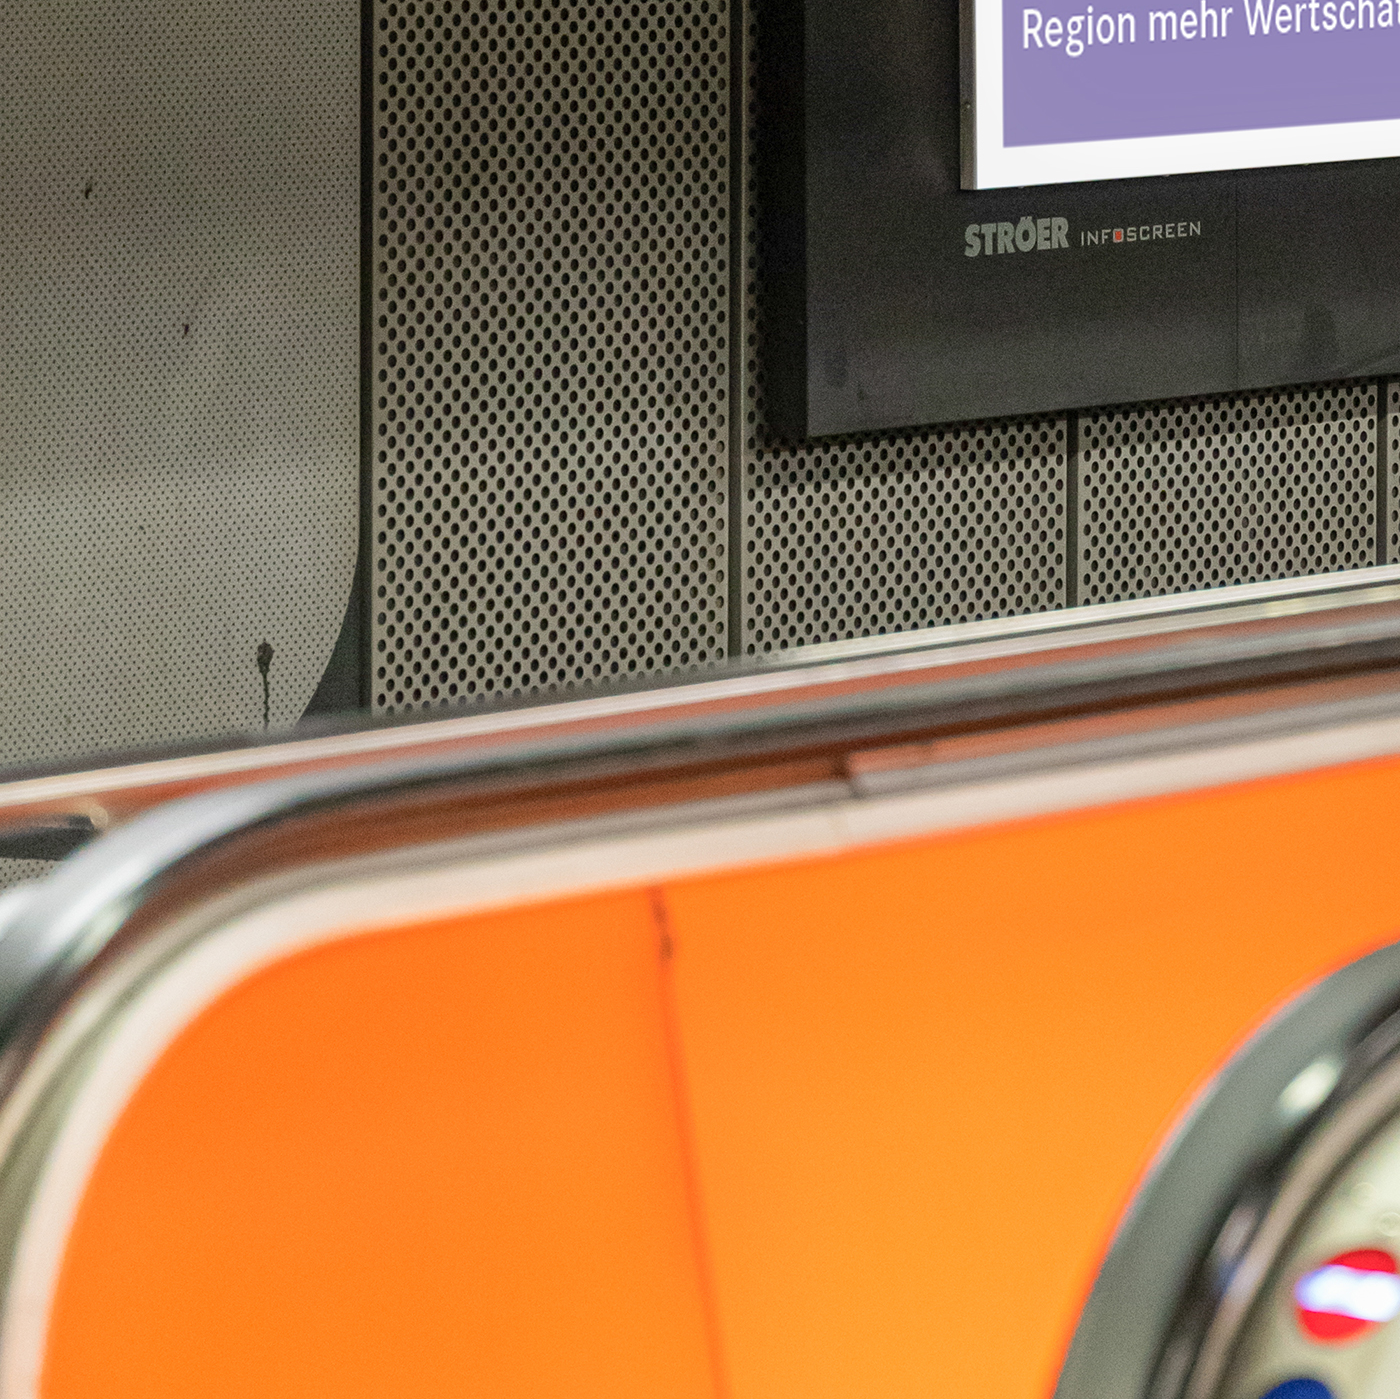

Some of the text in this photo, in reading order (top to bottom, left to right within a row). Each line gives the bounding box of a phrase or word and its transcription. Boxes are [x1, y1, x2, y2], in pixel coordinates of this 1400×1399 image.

[1023, 5, 1136, 58] Region
[1148, 0, 1234, 42] mehr
[964, 216, 1201, 257] STRÖER INFOSCREEN
